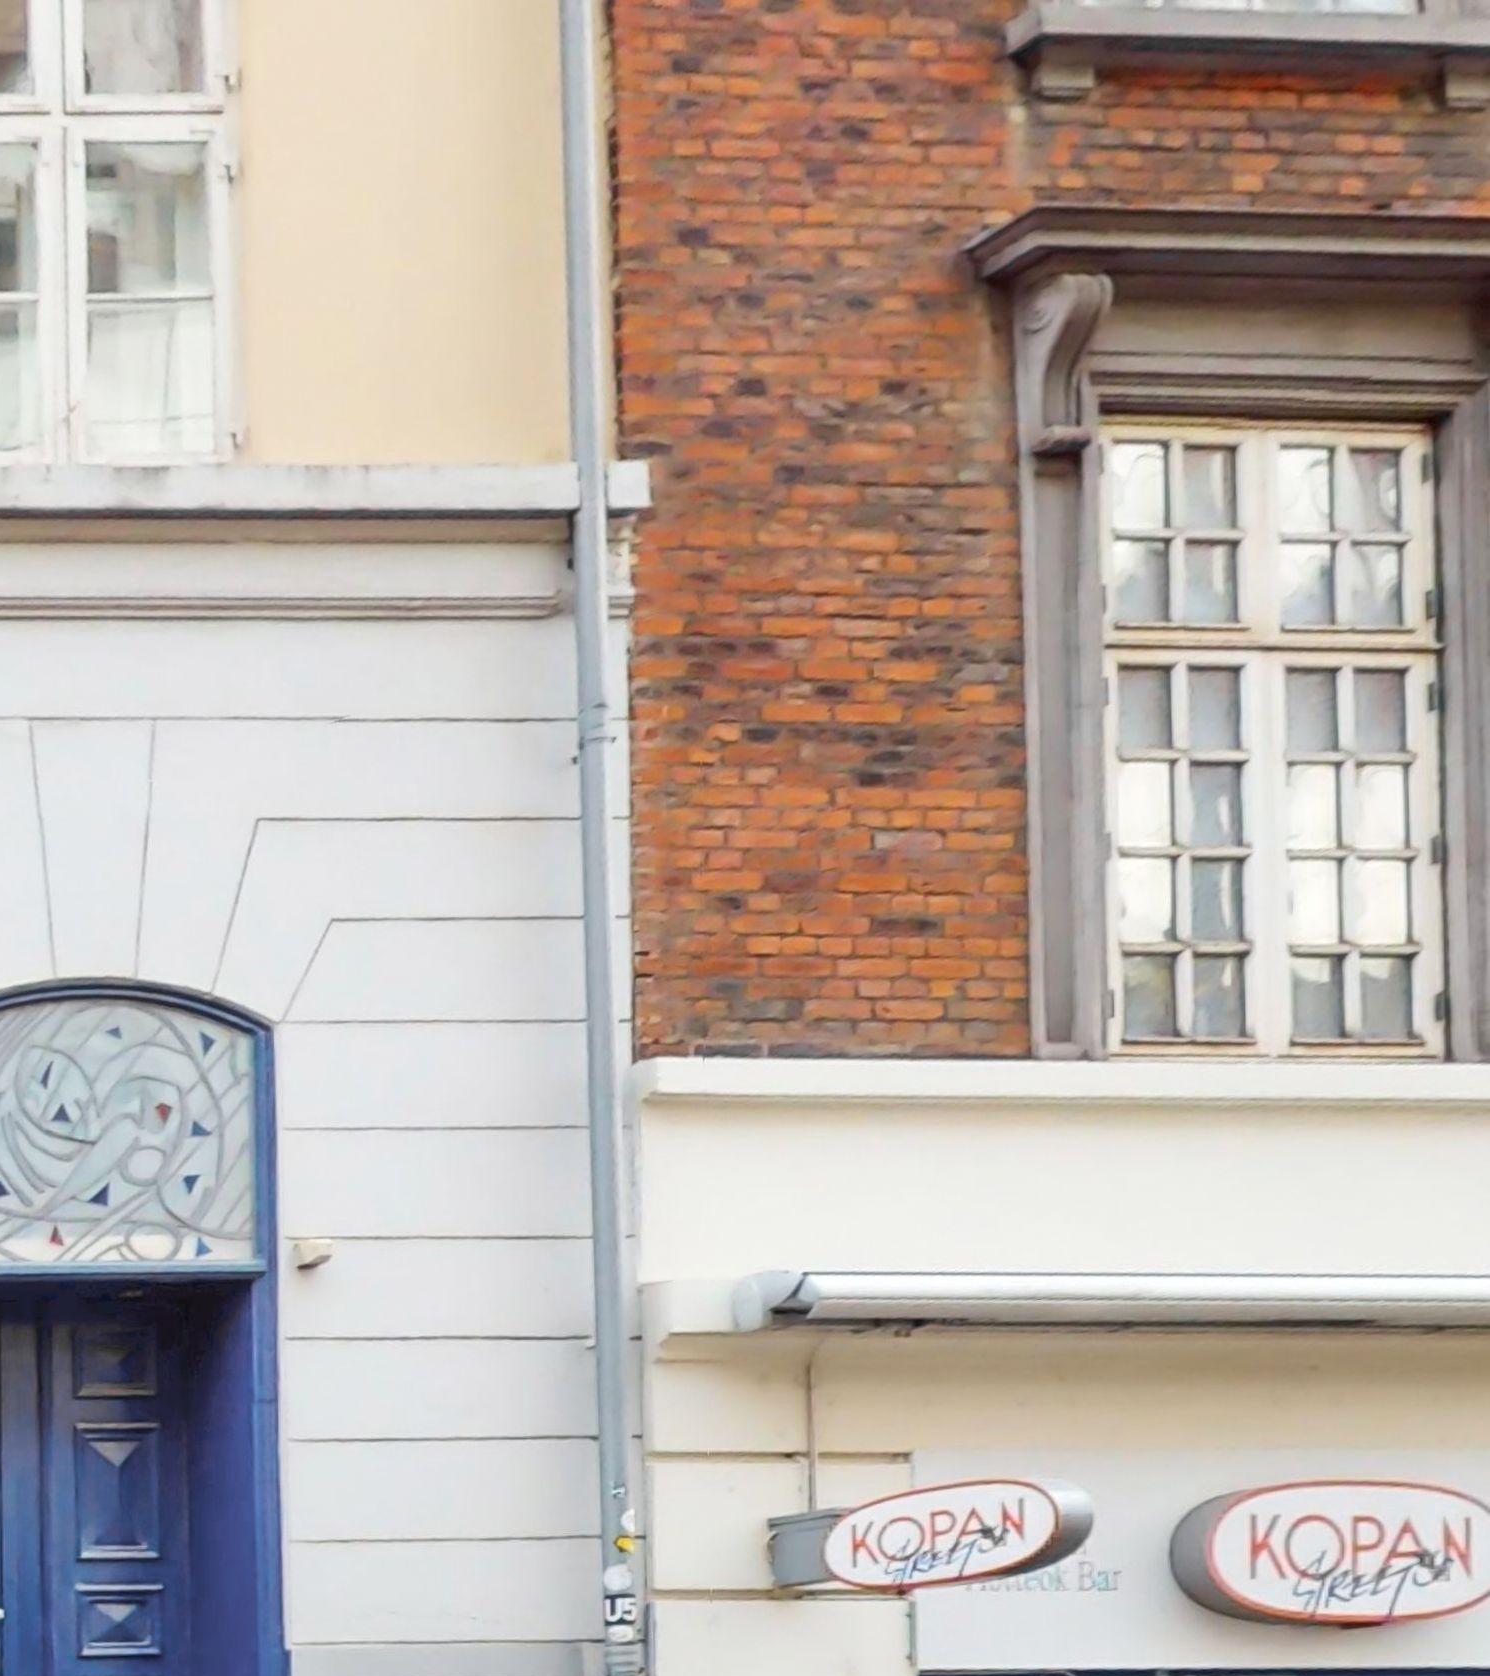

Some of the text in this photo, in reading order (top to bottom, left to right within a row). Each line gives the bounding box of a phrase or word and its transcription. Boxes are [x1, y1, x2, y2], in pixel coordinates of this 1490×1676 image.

[850, 1497, 1026, 1568] KOPAN
[1249, 1513, 1474, 1581] KOPAN
[1076, 1561, 1122, 1592] Bar
